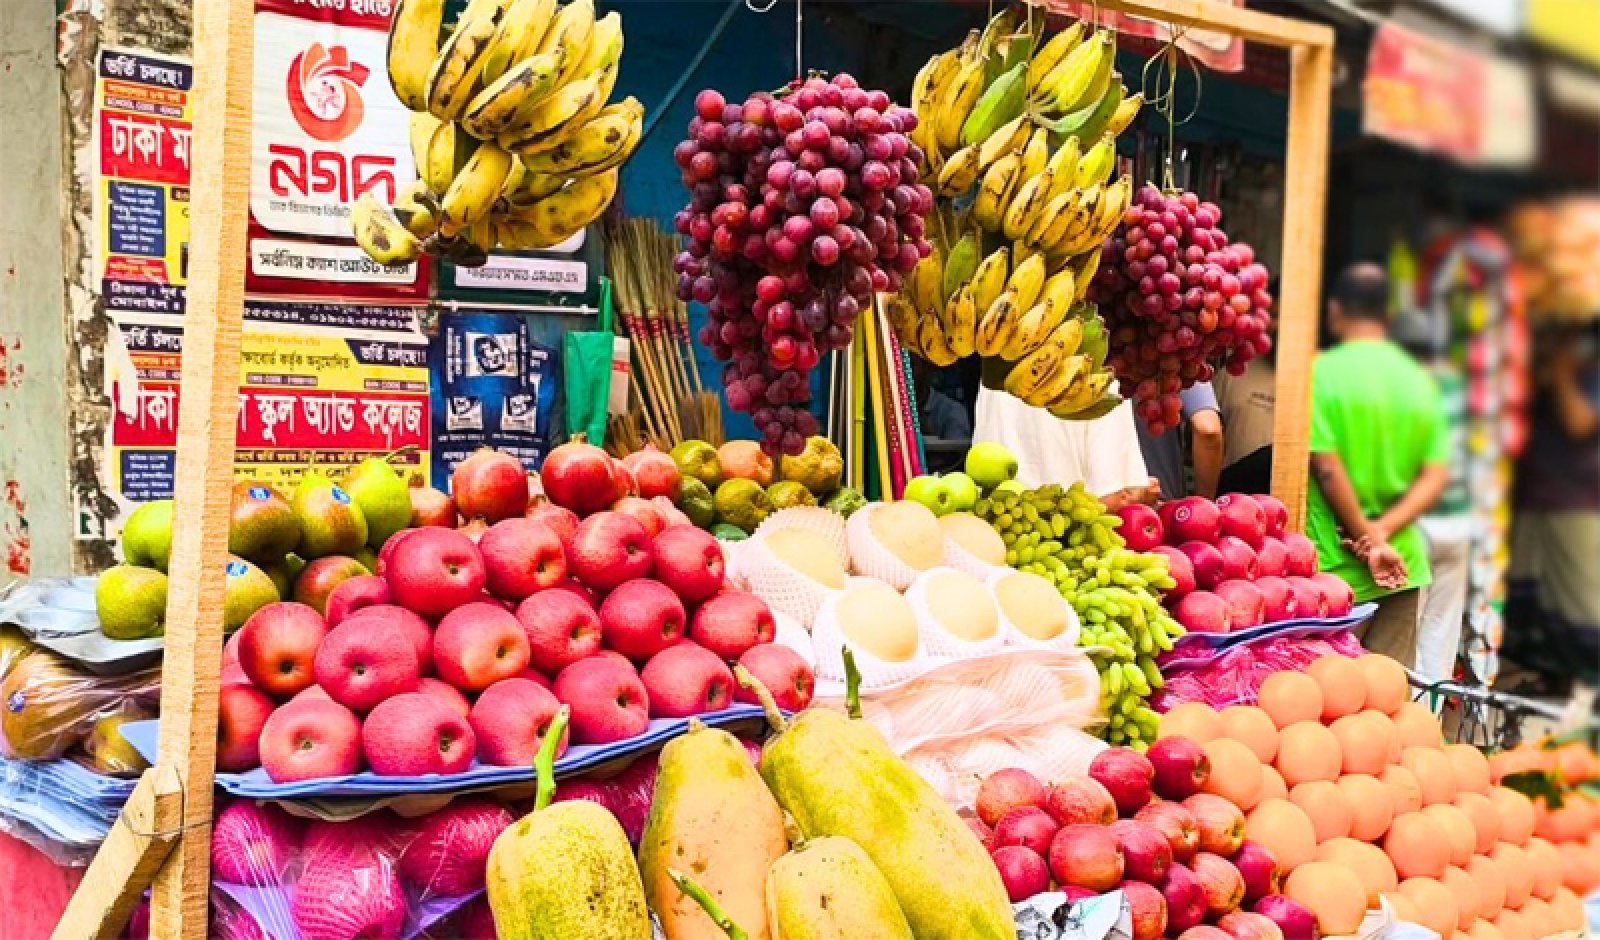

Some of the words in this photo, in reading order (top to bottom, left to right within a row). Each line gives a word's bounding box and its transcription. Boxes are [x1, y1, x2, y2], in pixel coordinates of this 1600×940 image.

[107, 114, 164, 168] ঢাকা
[268, 143, 397, 207] নগদ
[130, 387, 177, 431] াকা
[253, 394, 298, 446] স্কুল
[359, 399, 423, 439] কলেজ
